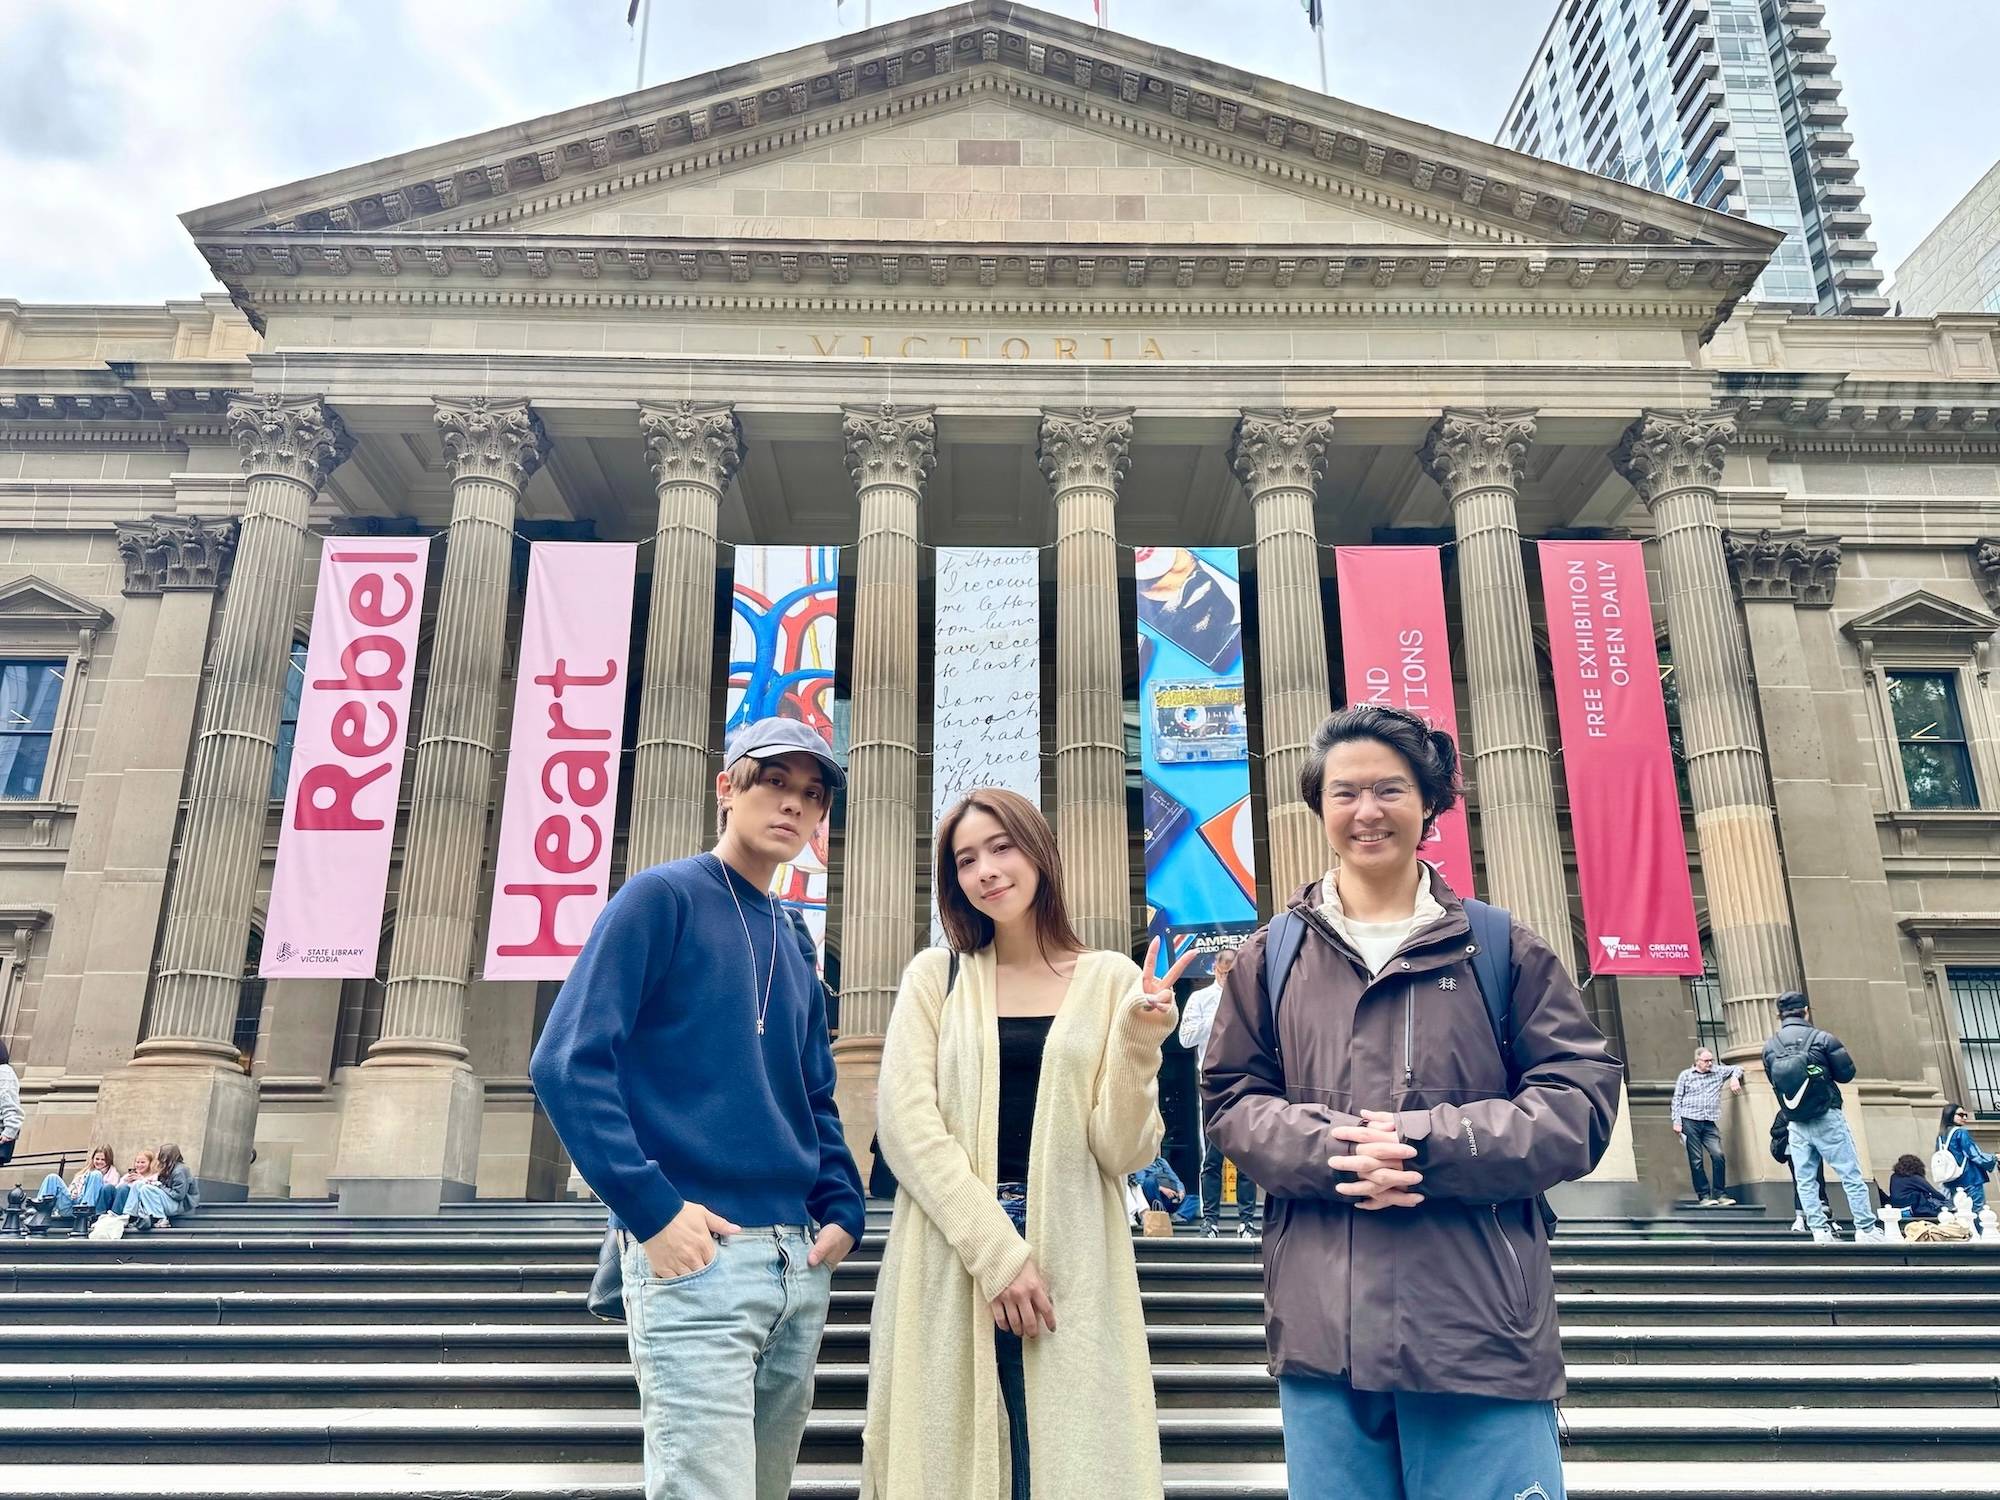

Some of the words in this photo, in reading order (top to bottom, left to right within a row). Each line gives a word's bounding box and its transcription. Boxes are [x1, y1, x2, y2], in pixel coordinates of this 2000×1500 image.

[808, 334, 1165, 361] VICTORIA
[1596, 559, 1621, 618] DAILY
[1567, 560, 1600, 679] EXHIBITION
[1399, 629, 1432, 722] TIONS
[1605, 627, 1630, 687] OPEN
[293, 552, 418, 831] Rebel
[1366, 667, 1392, 706] ND
[1583, 688, 1607, 737] FREE
[496, 657, 618, 957] Heart
[301, 955, 339, 963] VICTORIA
[307, 948, 329, 956] STATE
[331, 948, 364, 956] LIBRARY
[1195, 933, 1249, 948] AMPEX
[1648, 943, 1689, 952] CREATIVE
[1649, 951, 1690, 959] VICTORIA
